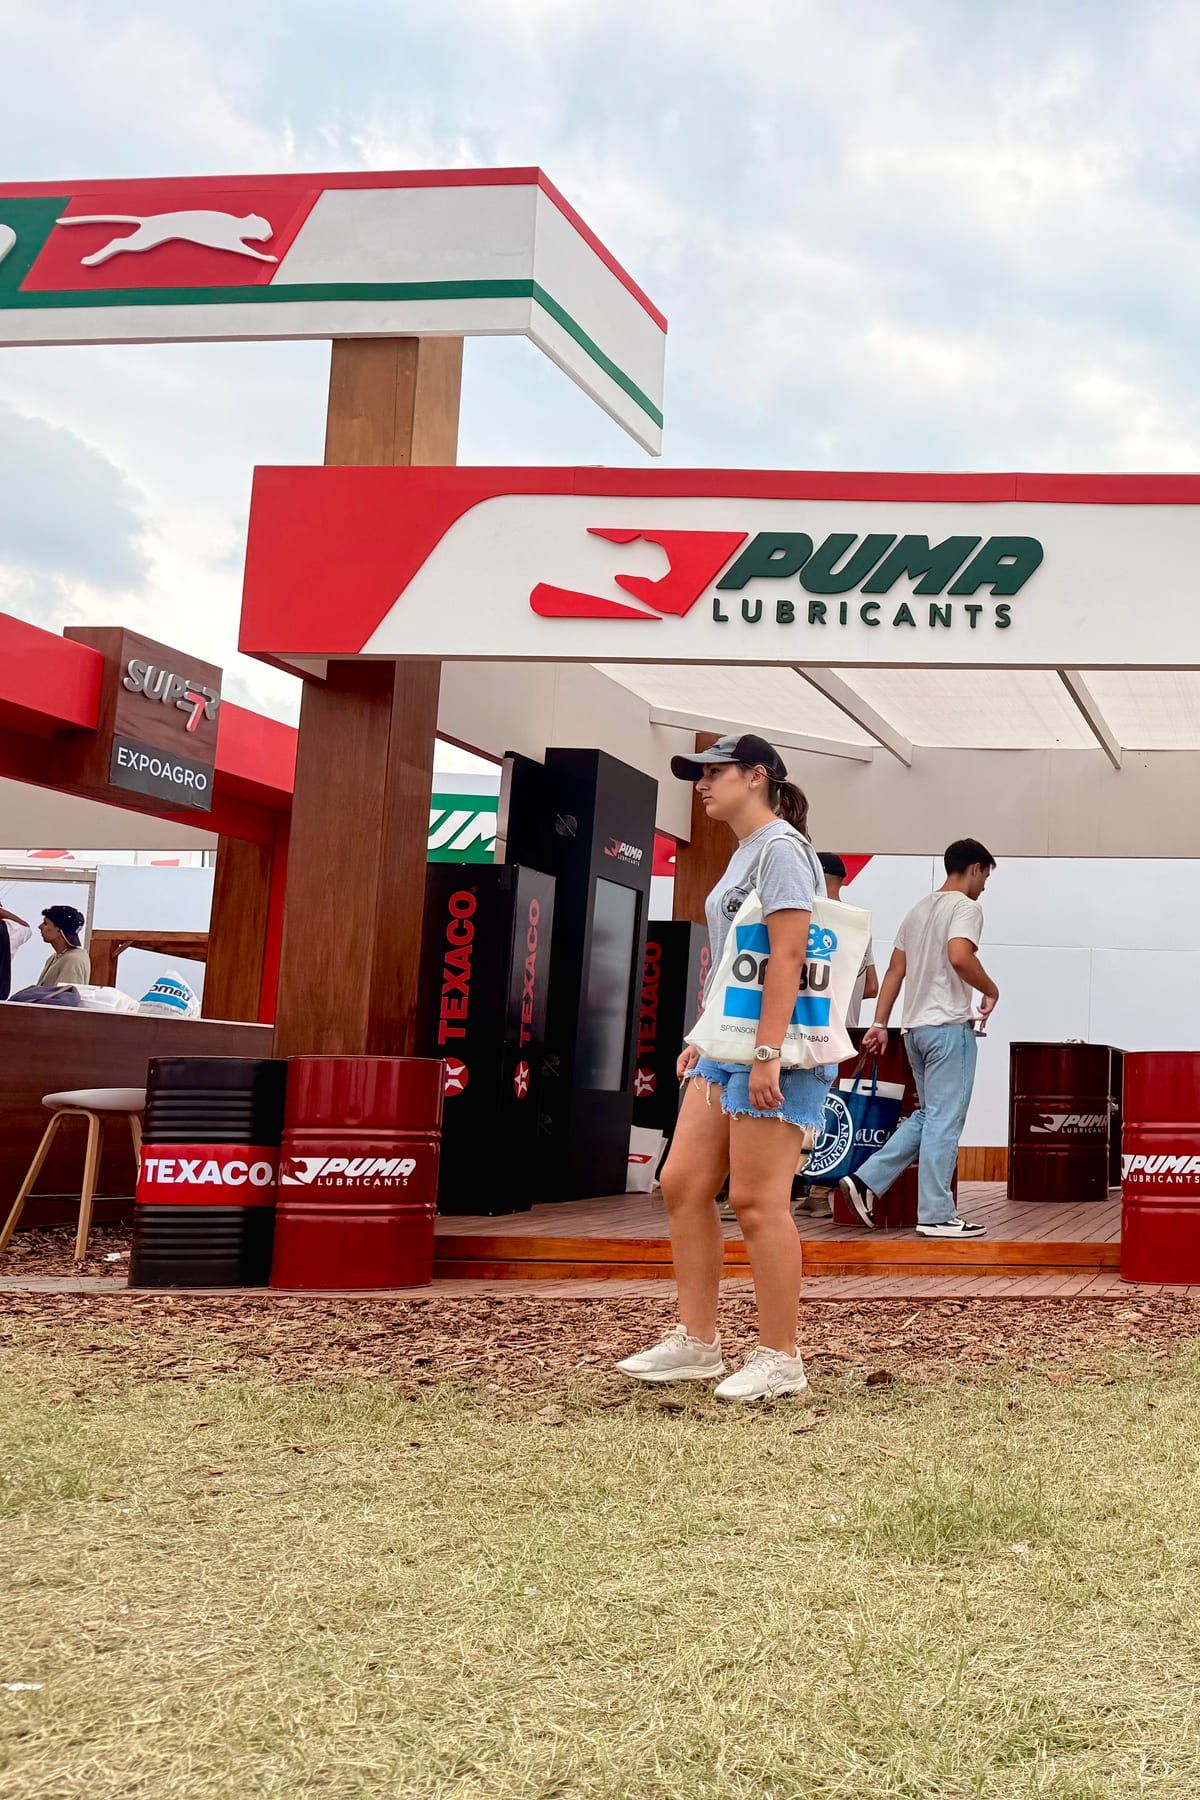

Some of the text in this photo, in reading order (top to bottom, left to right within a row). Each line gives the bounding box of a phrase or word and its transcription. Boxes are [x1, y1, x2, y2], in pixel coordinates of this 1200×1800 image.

[715, 531, 1045, 596] PUMA
[712, 598, 1013, 630] LUBRICANTS
[116, 747, 208, 791] EXPOAGRO
[427, 809, 498, 852] UM
[618, 842, 643, 861] PUMA
[437, 890, 478, 1046] TEXACO
[519, 898, 541, 1049] TEXACO
[636, 941, 663, 1060] TEXACO
[811, 1097, 849, 1171] LICA ARGENTINA
[317, 1177, 409, 1189] LUBRICANTS
[320, 1157, 417, 1177] PUMA
[1128, 1174, 1200, 1184] LUBRICANTS
